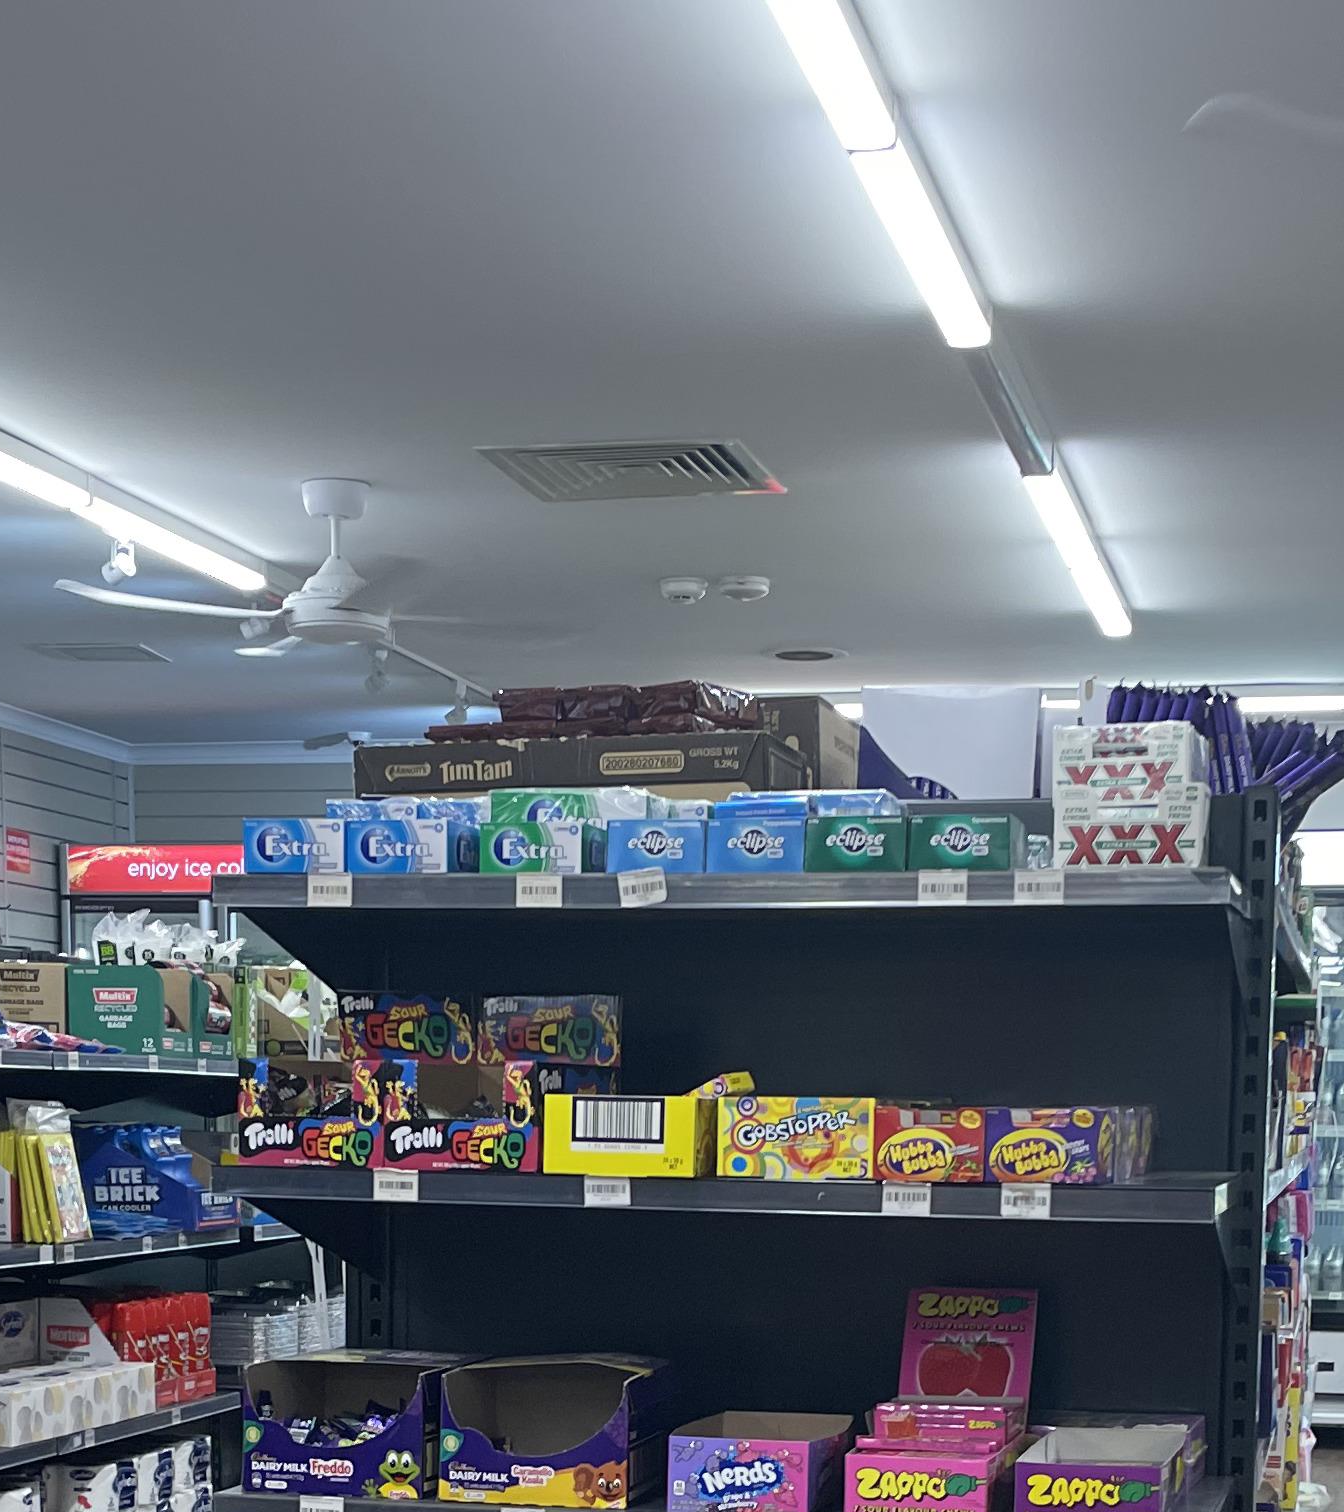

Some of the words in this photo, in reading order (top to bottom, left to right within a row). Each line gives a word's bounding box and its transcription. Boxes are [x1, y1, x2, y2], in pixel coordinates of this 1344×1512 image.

[265, 835, 330, 857] Extra
[369, 836, 433, 858] Extra
[502, 838, 567, 860] Extra
[627, 830, 685, 852] eclipse
[727, 830, 785, 853] eclipse
[825, 827, 885, 851] eclipse
[929, 831, 991, 851] eclipse
[127, 859, 180, 881] enjoy
[184, 858, 212, 877] ice
[216, 858, 246, 876] col
[98, 991, 134, 1001] Multix
[94, 1004, 138, 1013] RECYCLED
[389, 1004, 428, 1019] SOUR
[533, 1005, 575, 1021] SOUR
[141, 1037, 155, 1048] 12
[365, 1013, 451, 1058] GECKO
[507, 1015, 594, 1058] GECKO
[244, 1119, 295, 1149] Trolli
[321, 1120, 356, 1136] SOUR
[389, 1123, 444, 1154] Trolli
[472, 1122, 507, 1139] SOUR
[301, 1129, 373, 1168] GECKO
[451, 1129, 524, 1169] GECKO
[889, 1140, 934, 1163] Hubba
[1001, 1139, 1047, 1163] Hubba
[902, 1150, 947, 1175] Bubba
[1014, 1150, 1059, 1175] Bubba
[108, 1167, 145, 1185] ICE
[95, 1185, 160, 1203] BRICK
[120, 1204, 152, 1212] COOLER
[992, 1323, 1026, 1332] CHEWS
[251, 1461, 282, 1472] DAIRY
[283, 1462, 309, 1473] MILK
[311, 1459, 352, 1475] Freddo
[449, 1470, 478, 1481] DAIRY
[481, 1472, 510, 1484] MILK
[856, 1466, 947, 1500] ZAPPO
[1026, 1473, 1122, 1506] ZAPPO
